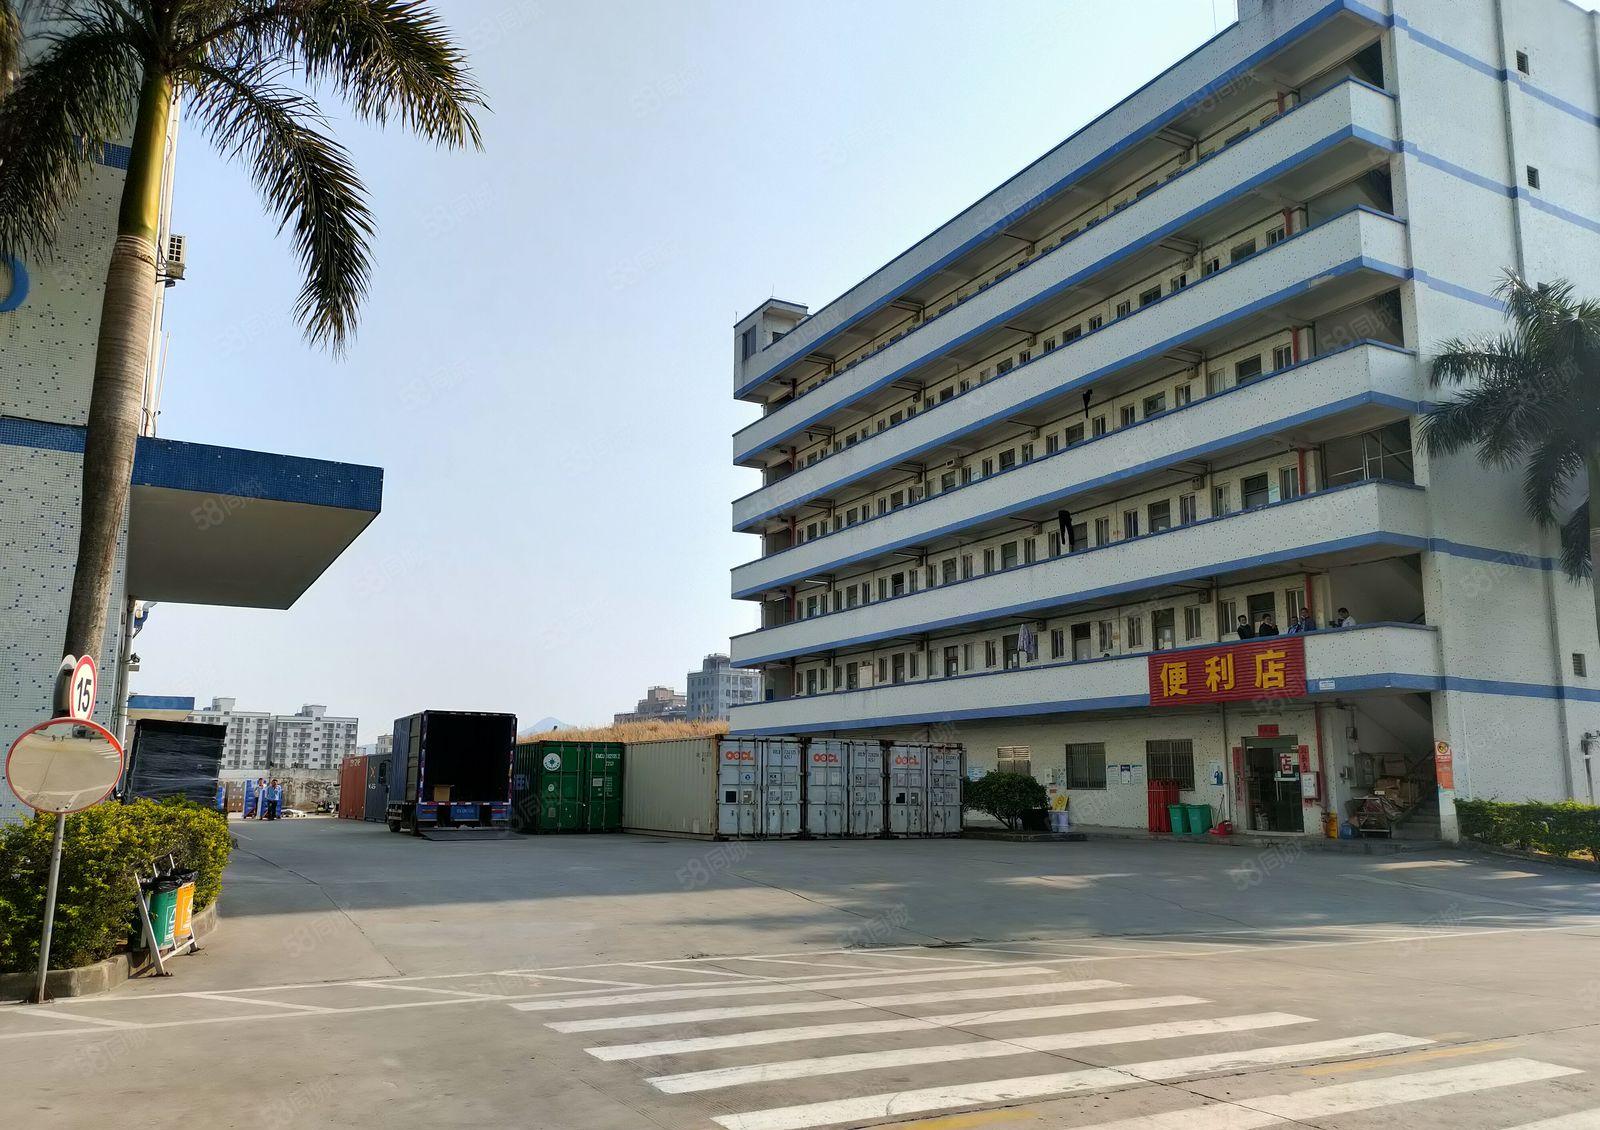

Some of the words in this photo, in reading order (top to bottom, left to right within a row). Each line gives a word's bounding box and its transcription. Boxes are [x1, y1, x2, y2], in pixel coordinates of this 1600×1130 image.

[1159, 648, 1287, 698] 便利店
[76, 676, 92, 713] 15
[725, 750, 754, 761] OOCL
[813, 752, 839, 763] OOCL
[895, 754, 920, 765] OOCL
